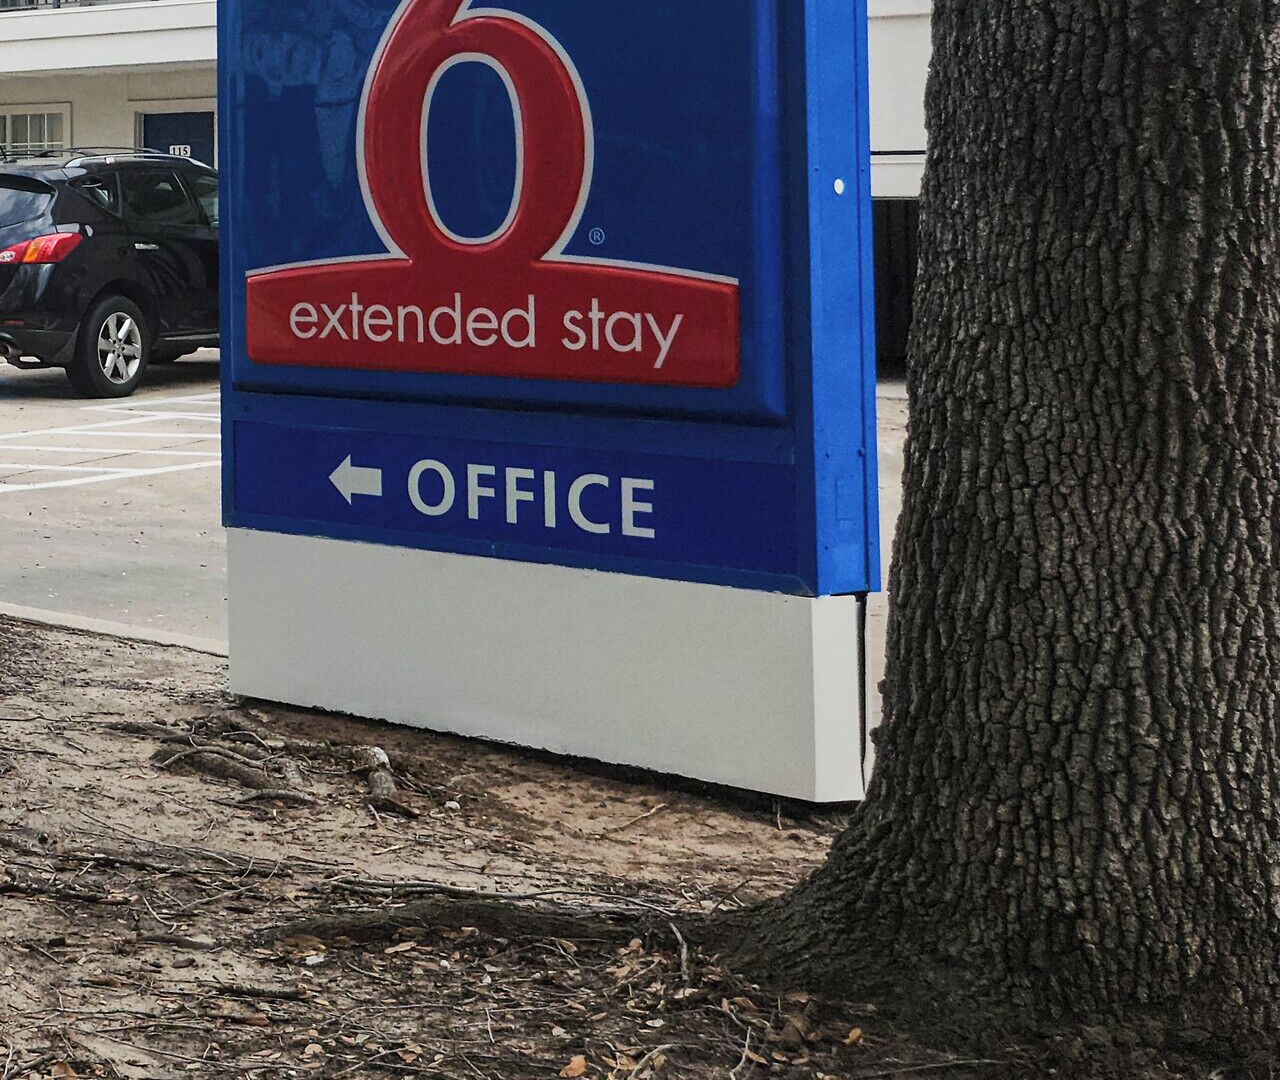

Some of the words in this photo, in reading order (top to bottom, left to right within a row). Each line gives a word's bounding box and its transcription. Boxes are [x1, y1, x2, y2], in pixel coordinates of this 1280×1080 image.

[171, 146, 189, 156] 115
[289, 292, 536, 349] extended
[561, 297, 684, 369] stay
[407, 458, 656, 539] OFFICE
